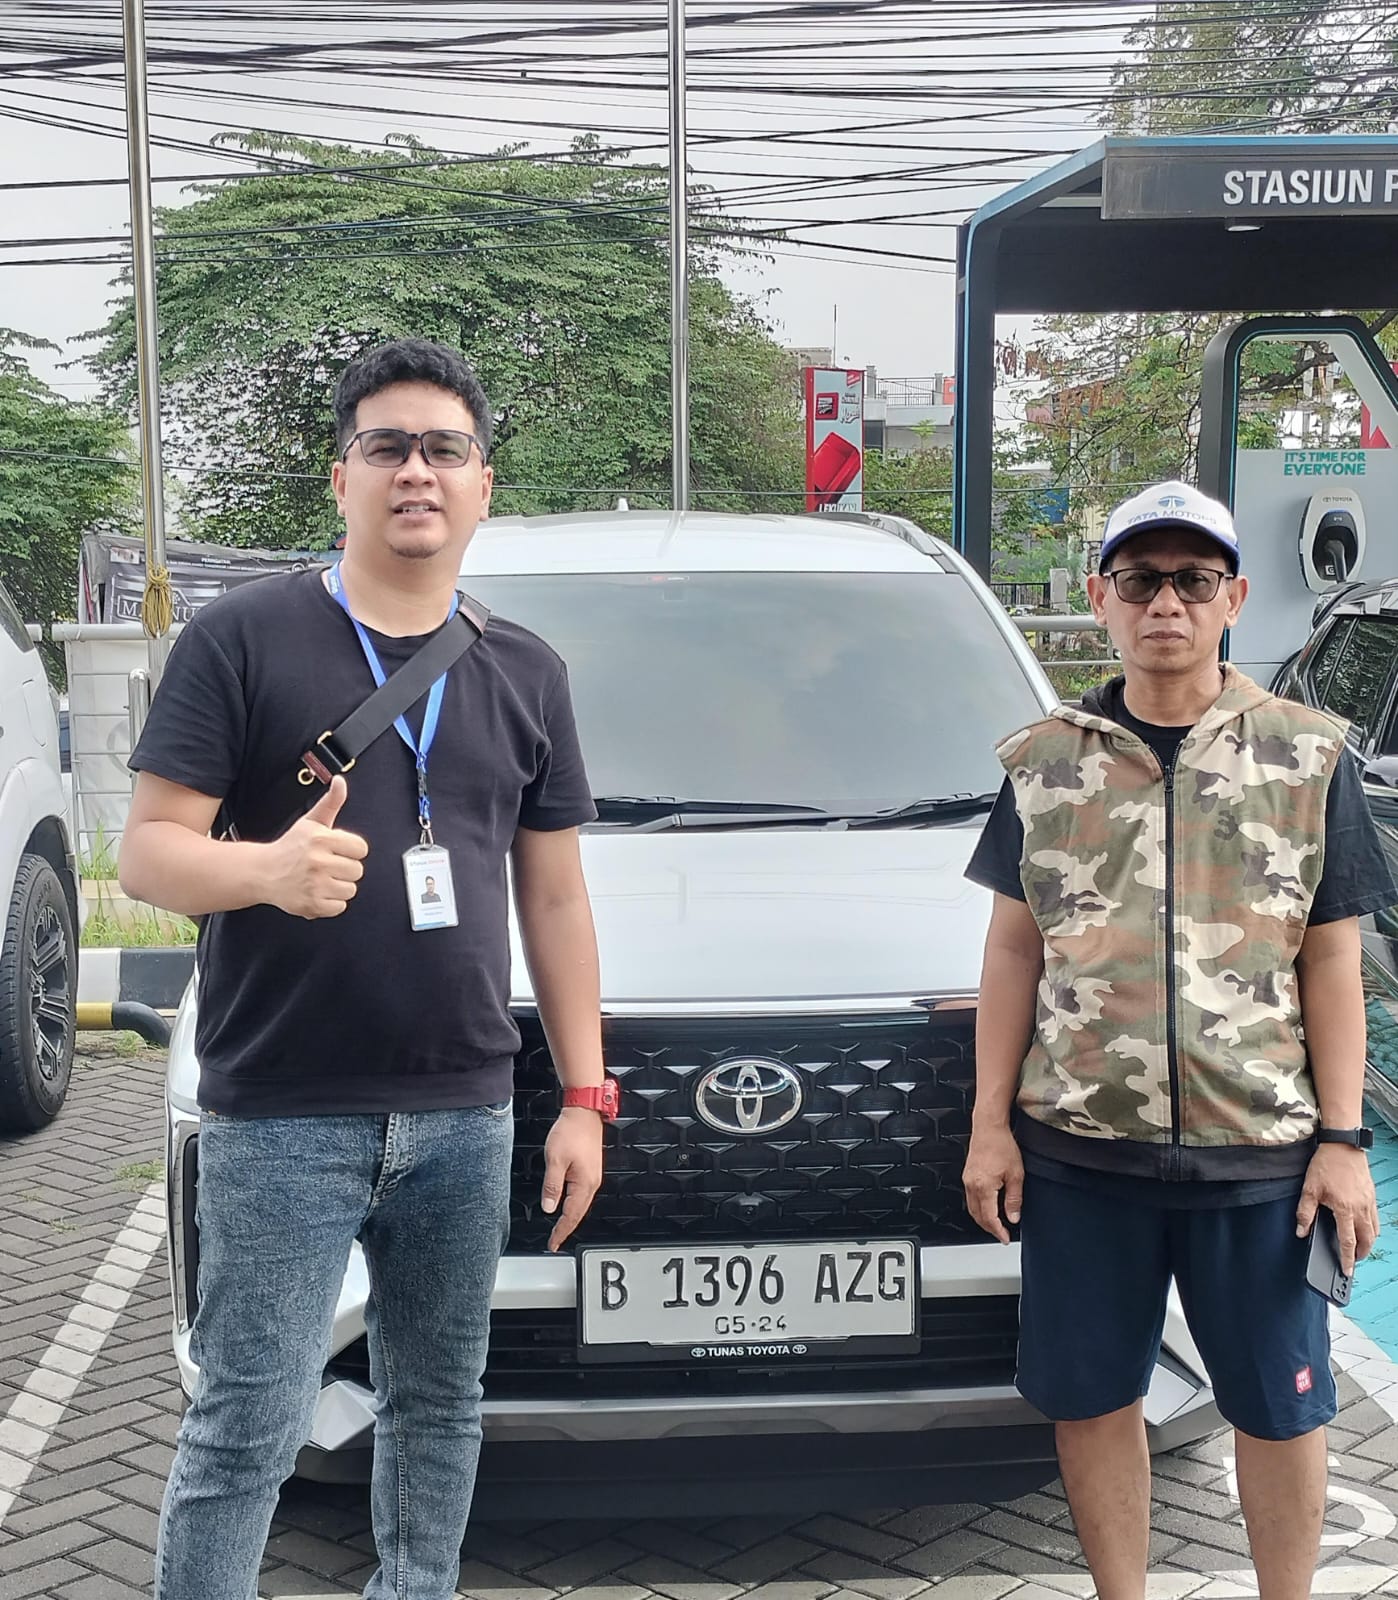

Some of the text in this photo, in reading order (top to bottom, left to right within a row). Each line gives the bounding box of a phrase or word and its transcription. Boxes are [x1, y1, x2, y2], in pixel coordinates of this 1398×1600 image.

[1223, 169, 1374, 205] STASIUN
[1284, 452, 1366, 463] IT'S TIME FOR
[1284, 463, 1366, 476] EVERYONE
[1127, 509, 1217, 526] TATA MOTORS
[601, 1251, 906, 1311] B 1396 AZG
[707, 1344, 791, 1357] TUNAS TOYOTA
